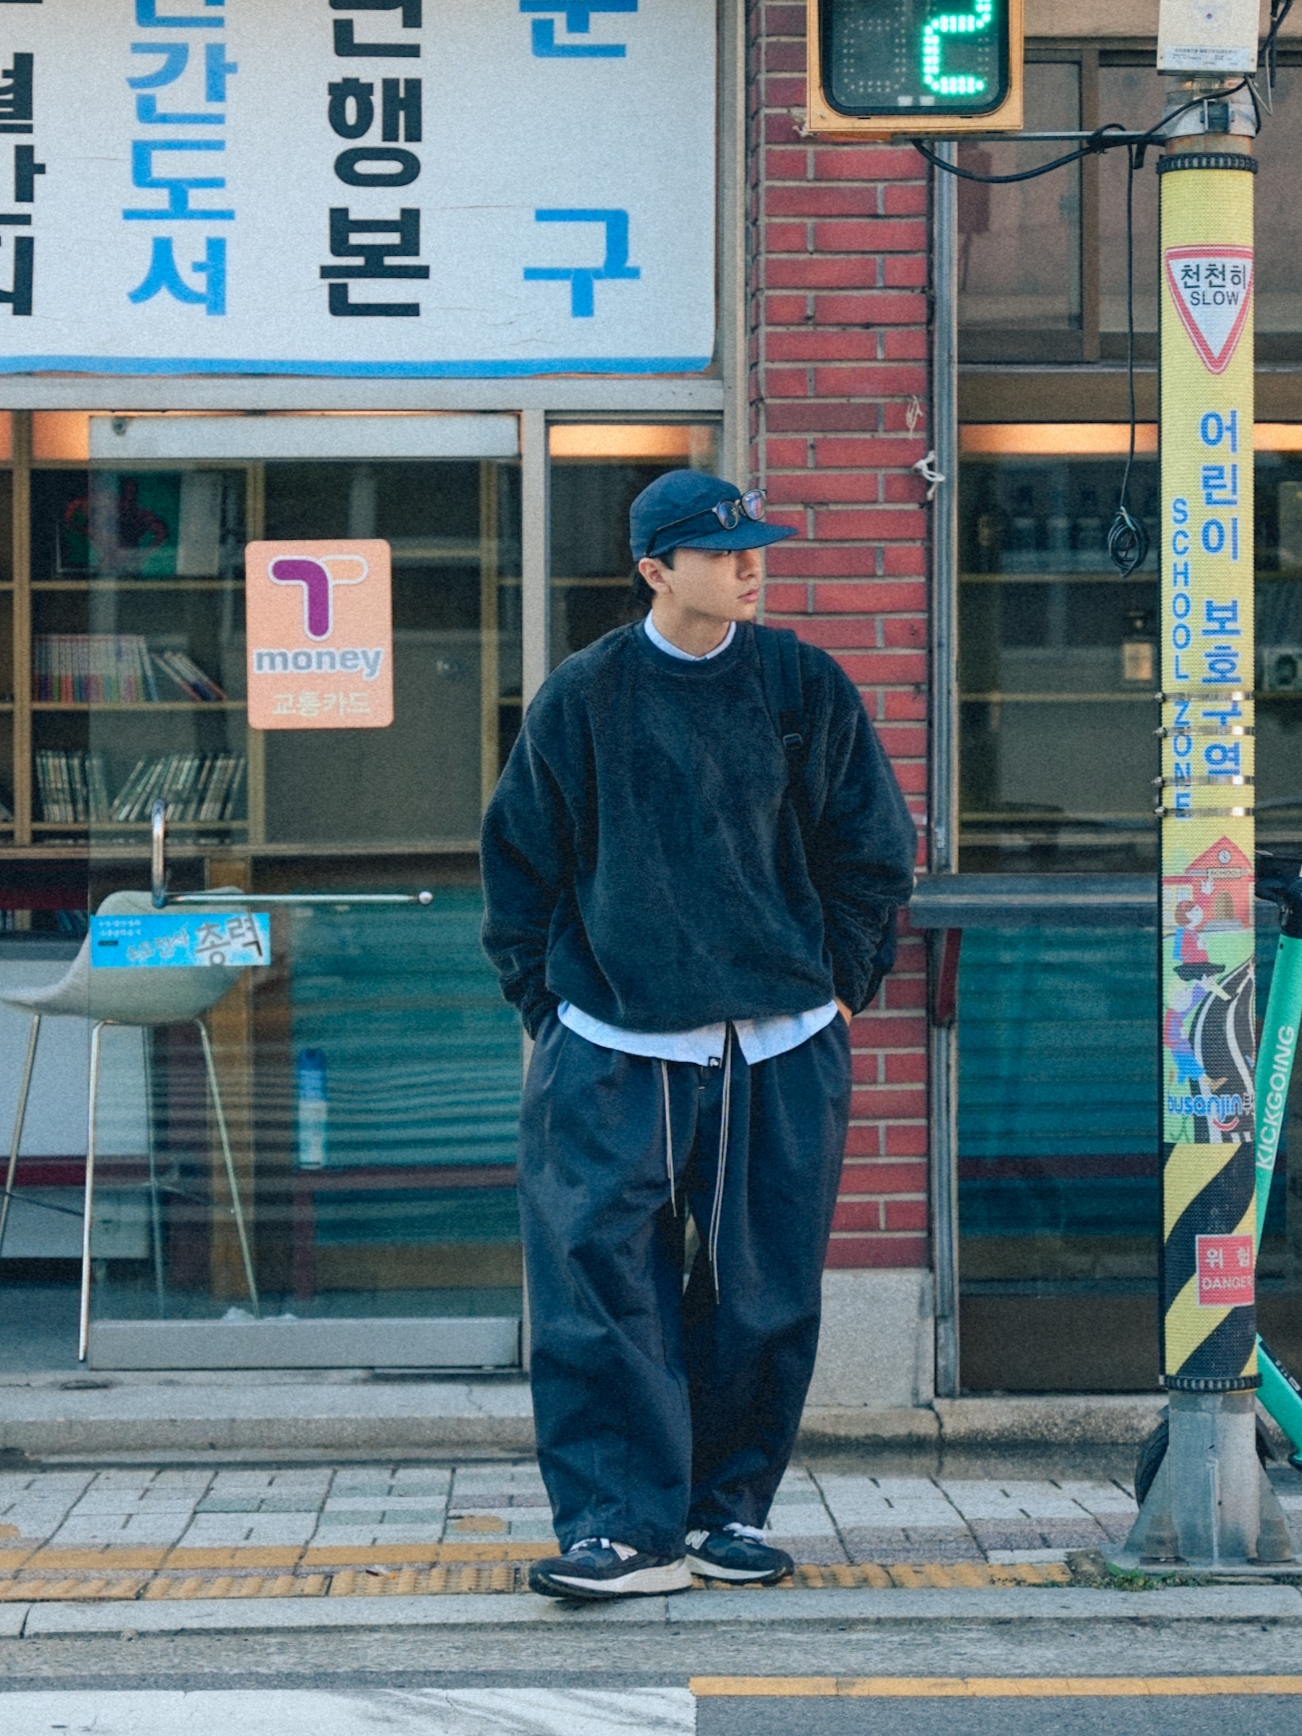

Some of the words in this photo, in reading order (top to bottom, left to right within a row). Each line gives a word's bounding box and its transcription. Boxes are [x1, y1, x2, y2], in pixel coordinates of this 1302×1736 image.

[923, 0, 992, 95] 2
[1181, 263, 1246, 290] 천천히
[1190, 290, 1239, 306] SLOW
[1200, 409, 1238, 561] 어린이
[1172, 498, 1192, 680] SCHOOL
[254, 648, 384, 680] money
[271, 691, 371, 717] 교통카드
[1173, 699, 1193, 819] ZONE
[1255, 1025, 1295, 1170] KICKGOING
